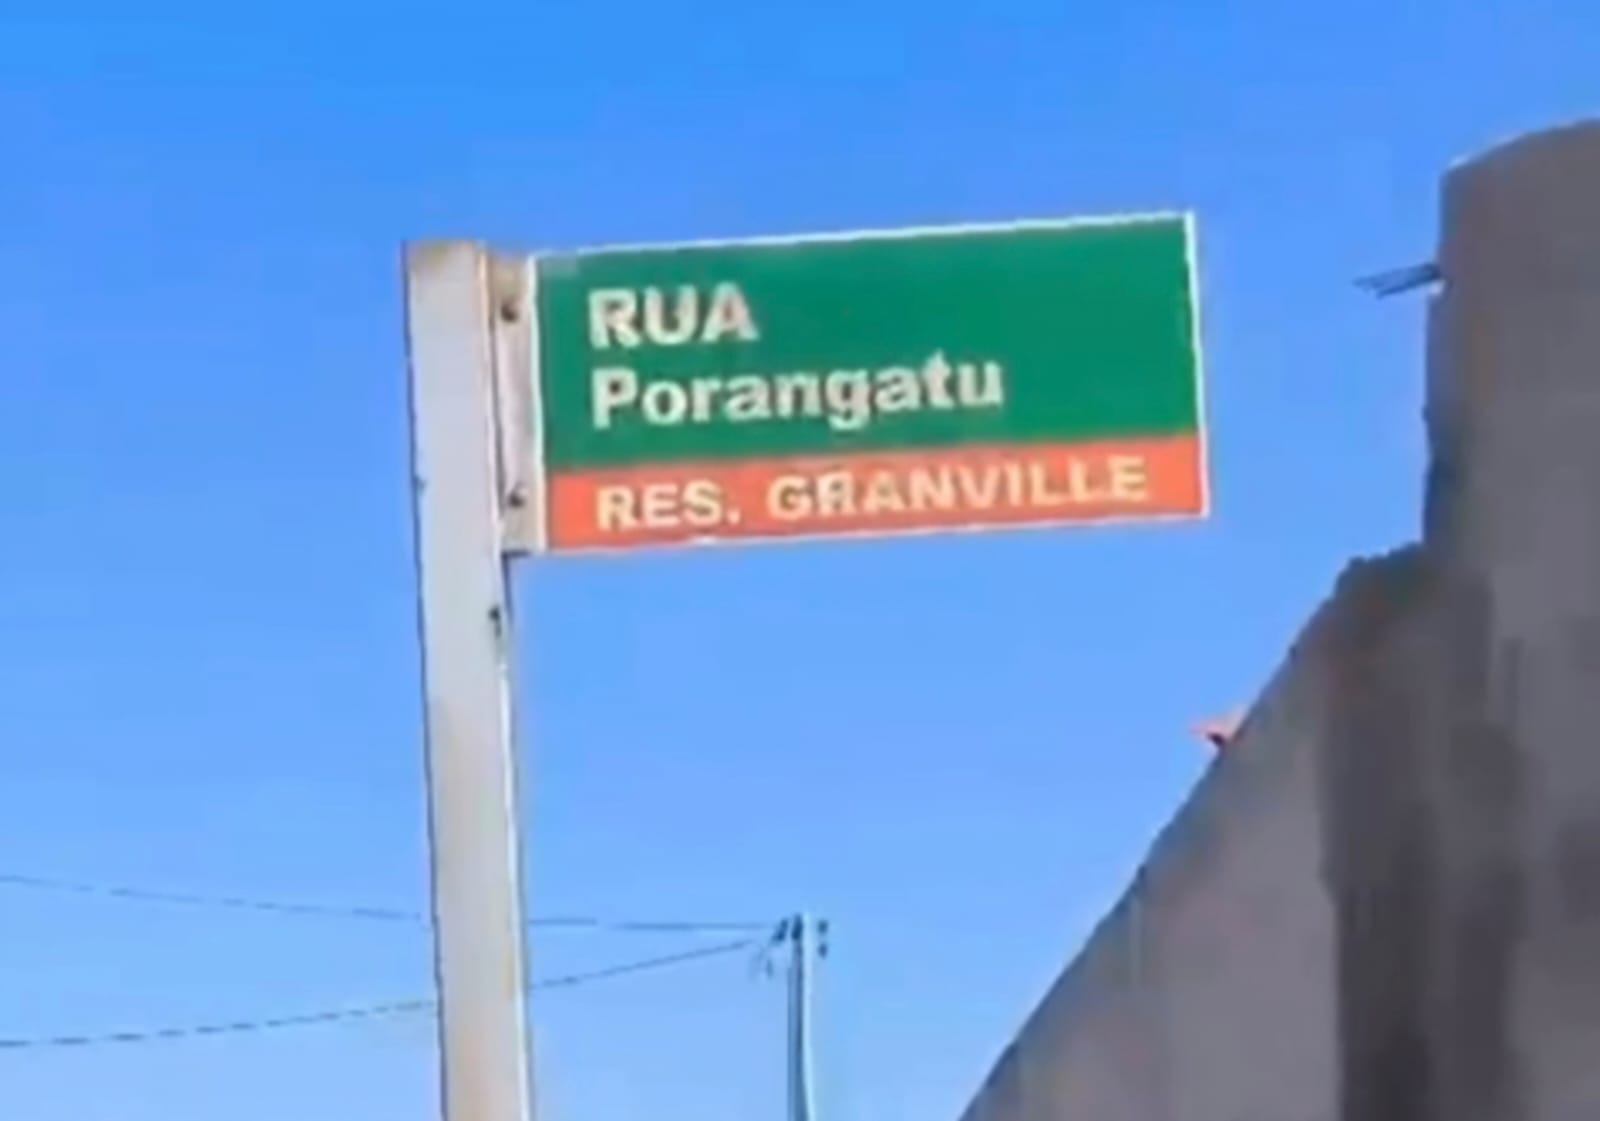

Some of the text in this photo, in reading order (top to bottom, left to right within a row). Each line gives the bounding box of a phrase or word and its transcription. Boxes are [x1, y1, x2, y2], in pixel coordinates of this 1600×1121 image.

[588, 282, 759, 349] RUA
[591, 351, 1006, 431] Porangatu
[597, 456, 1150, 532] RES. GRANVILLE
